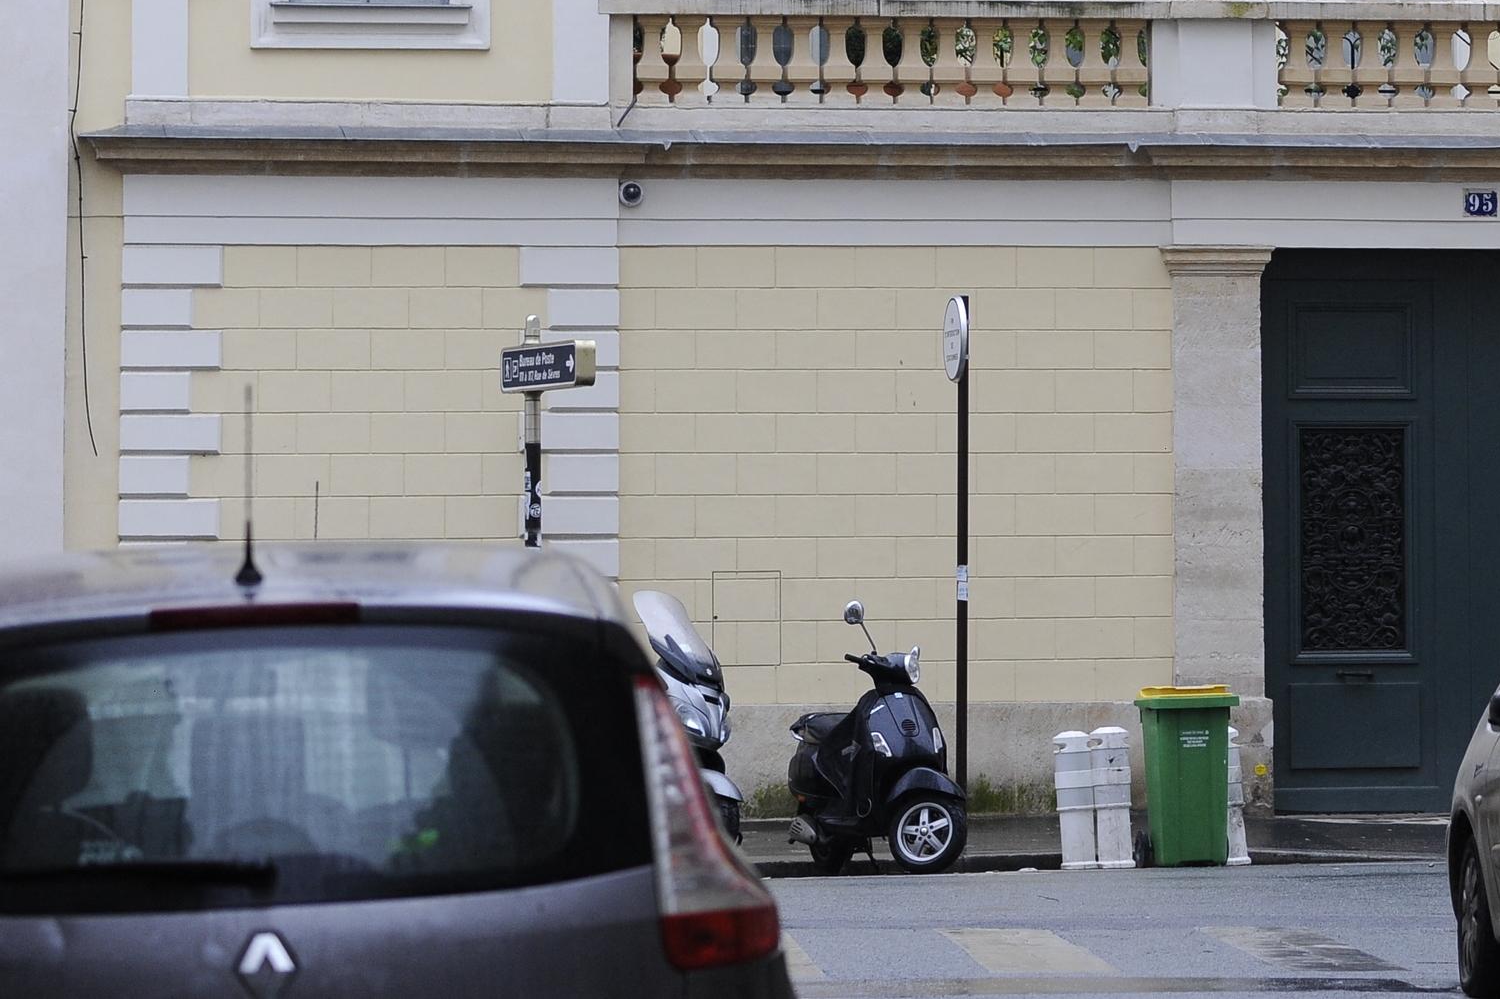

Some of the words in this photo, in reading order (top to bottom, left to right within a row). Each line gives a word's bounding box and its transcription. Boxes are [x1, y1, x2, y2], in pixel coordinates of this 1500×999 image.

[1469, 193, 1493, 212] 95
[535, 352, 541, 366] de
[541, 352, 554, 365] Poste
[541, 369, 547, 380] de
